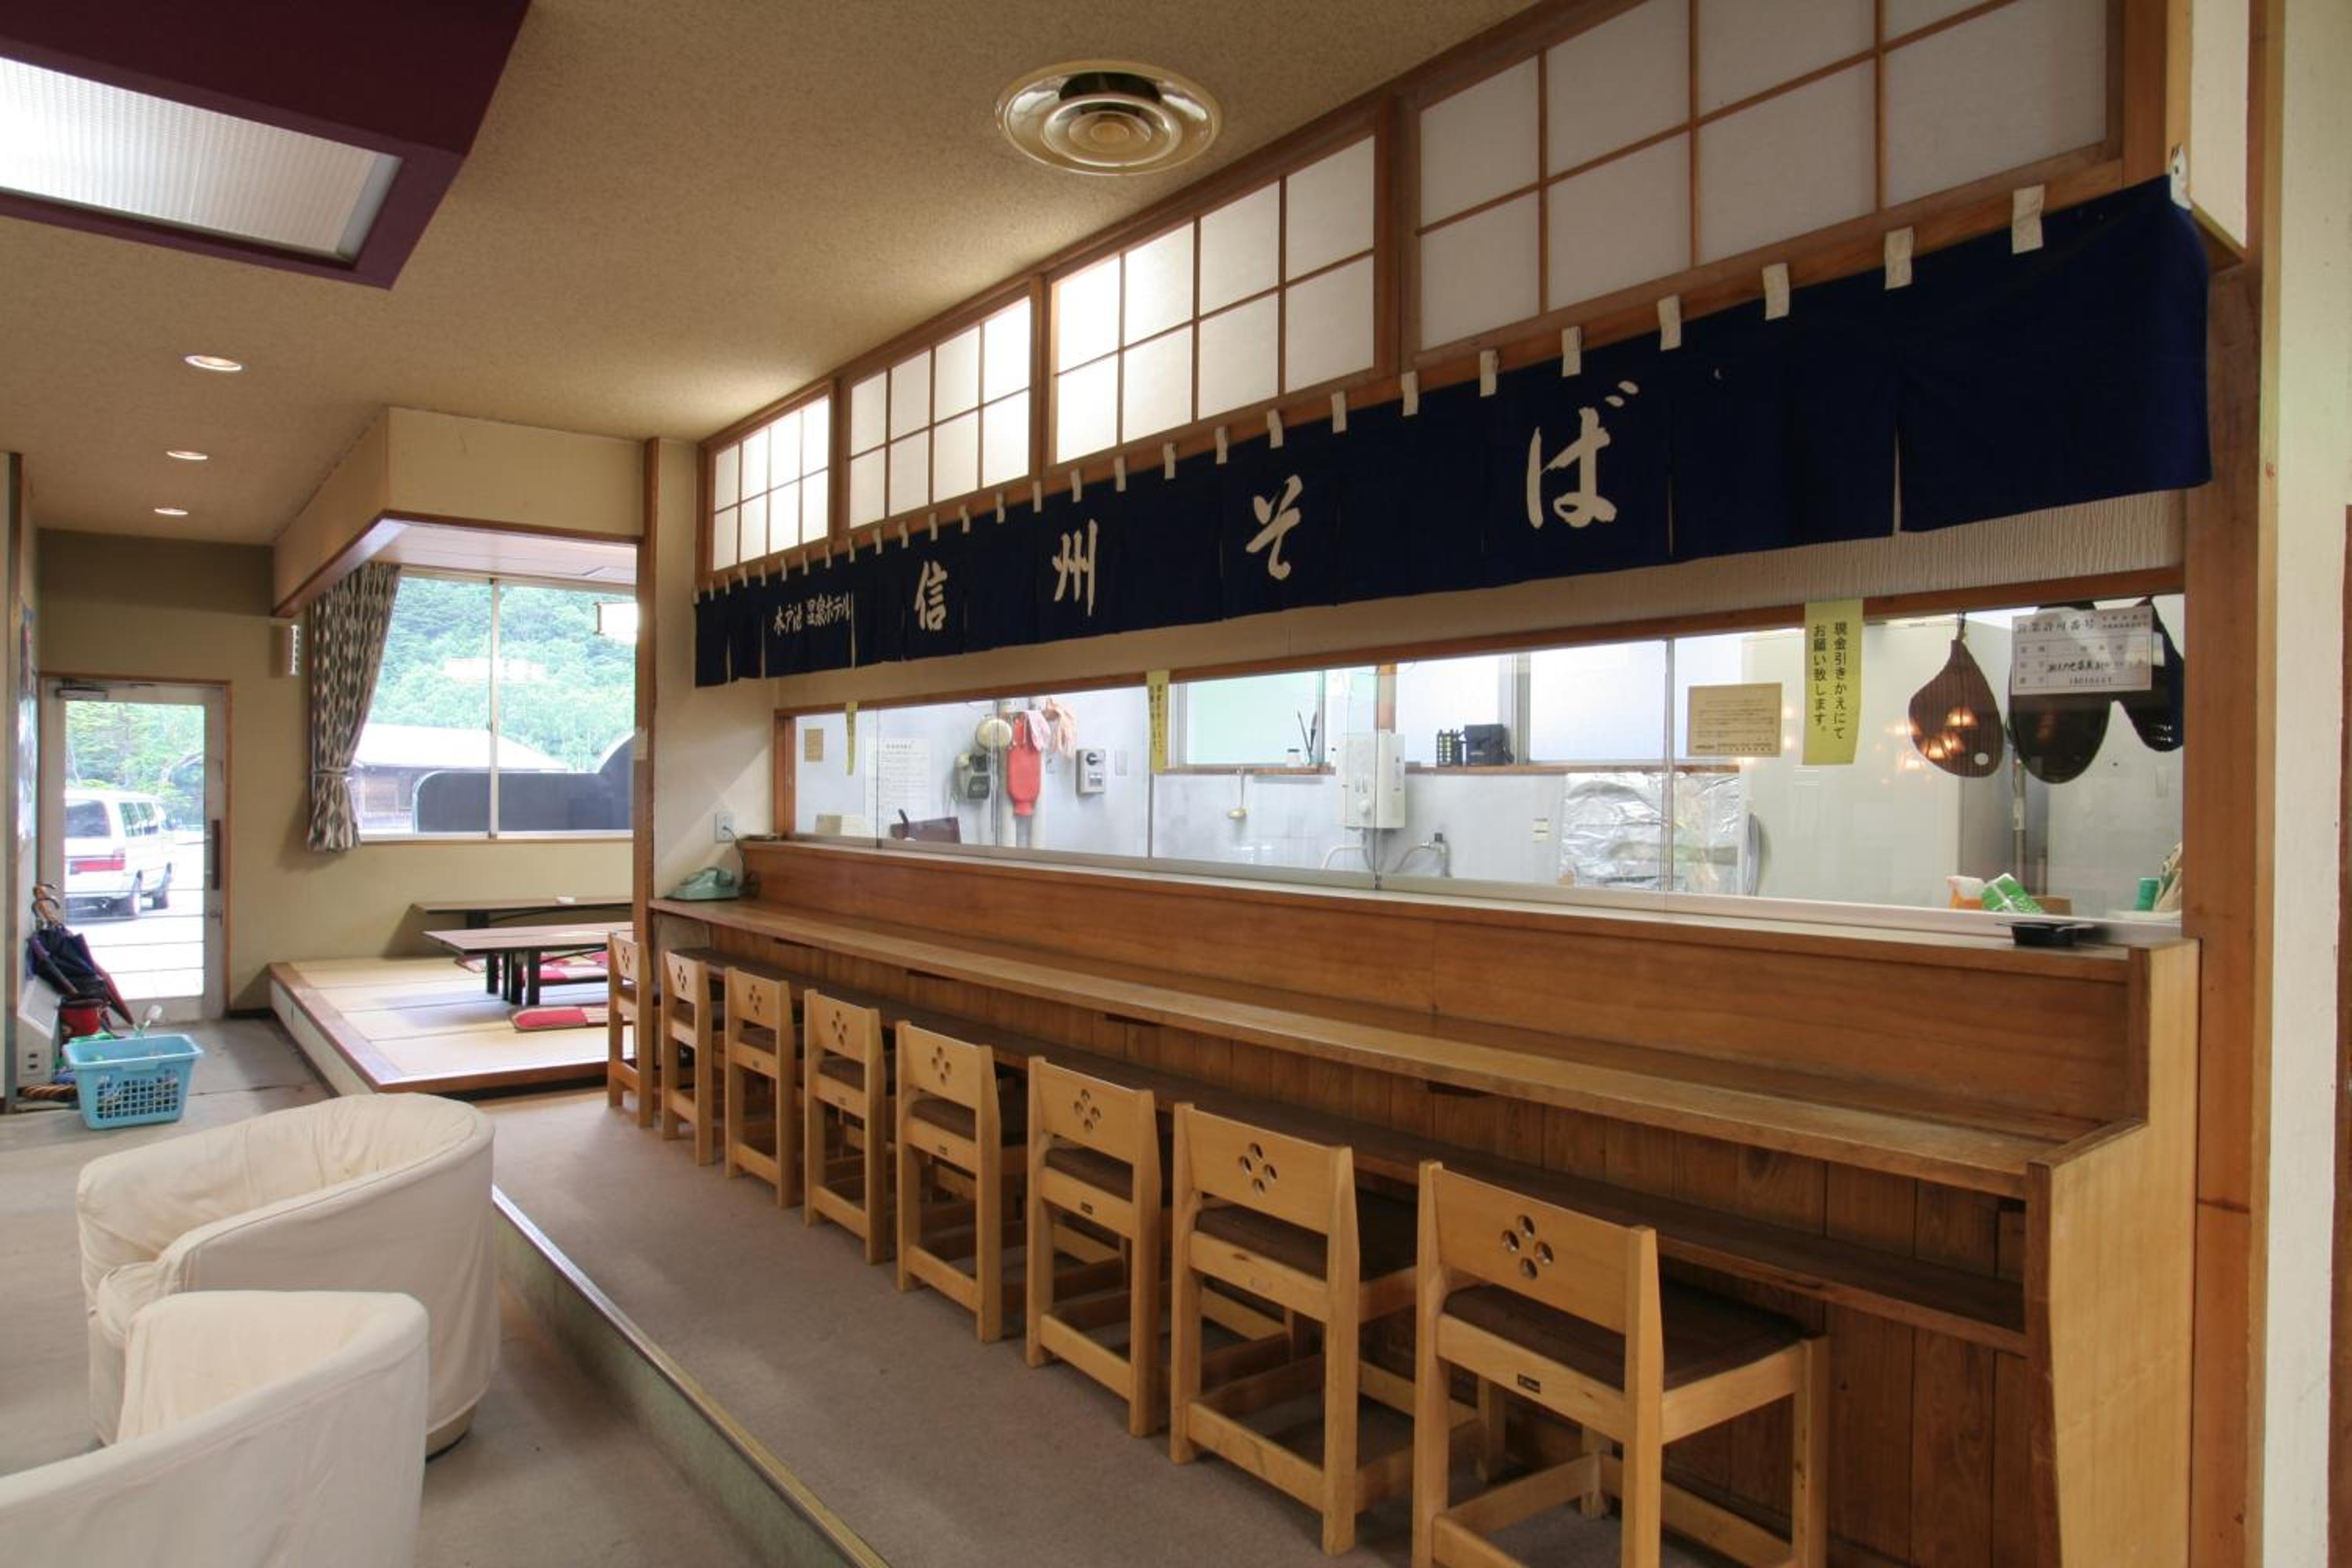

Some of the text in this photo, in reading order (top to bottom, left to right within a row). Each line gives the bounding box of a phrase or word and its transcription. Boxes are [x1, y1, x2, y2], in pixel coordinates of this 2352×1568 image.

[914, 380, 1639, 630] 信州そば
[1834, 622, 1847, 739] 現金引きかえにて
